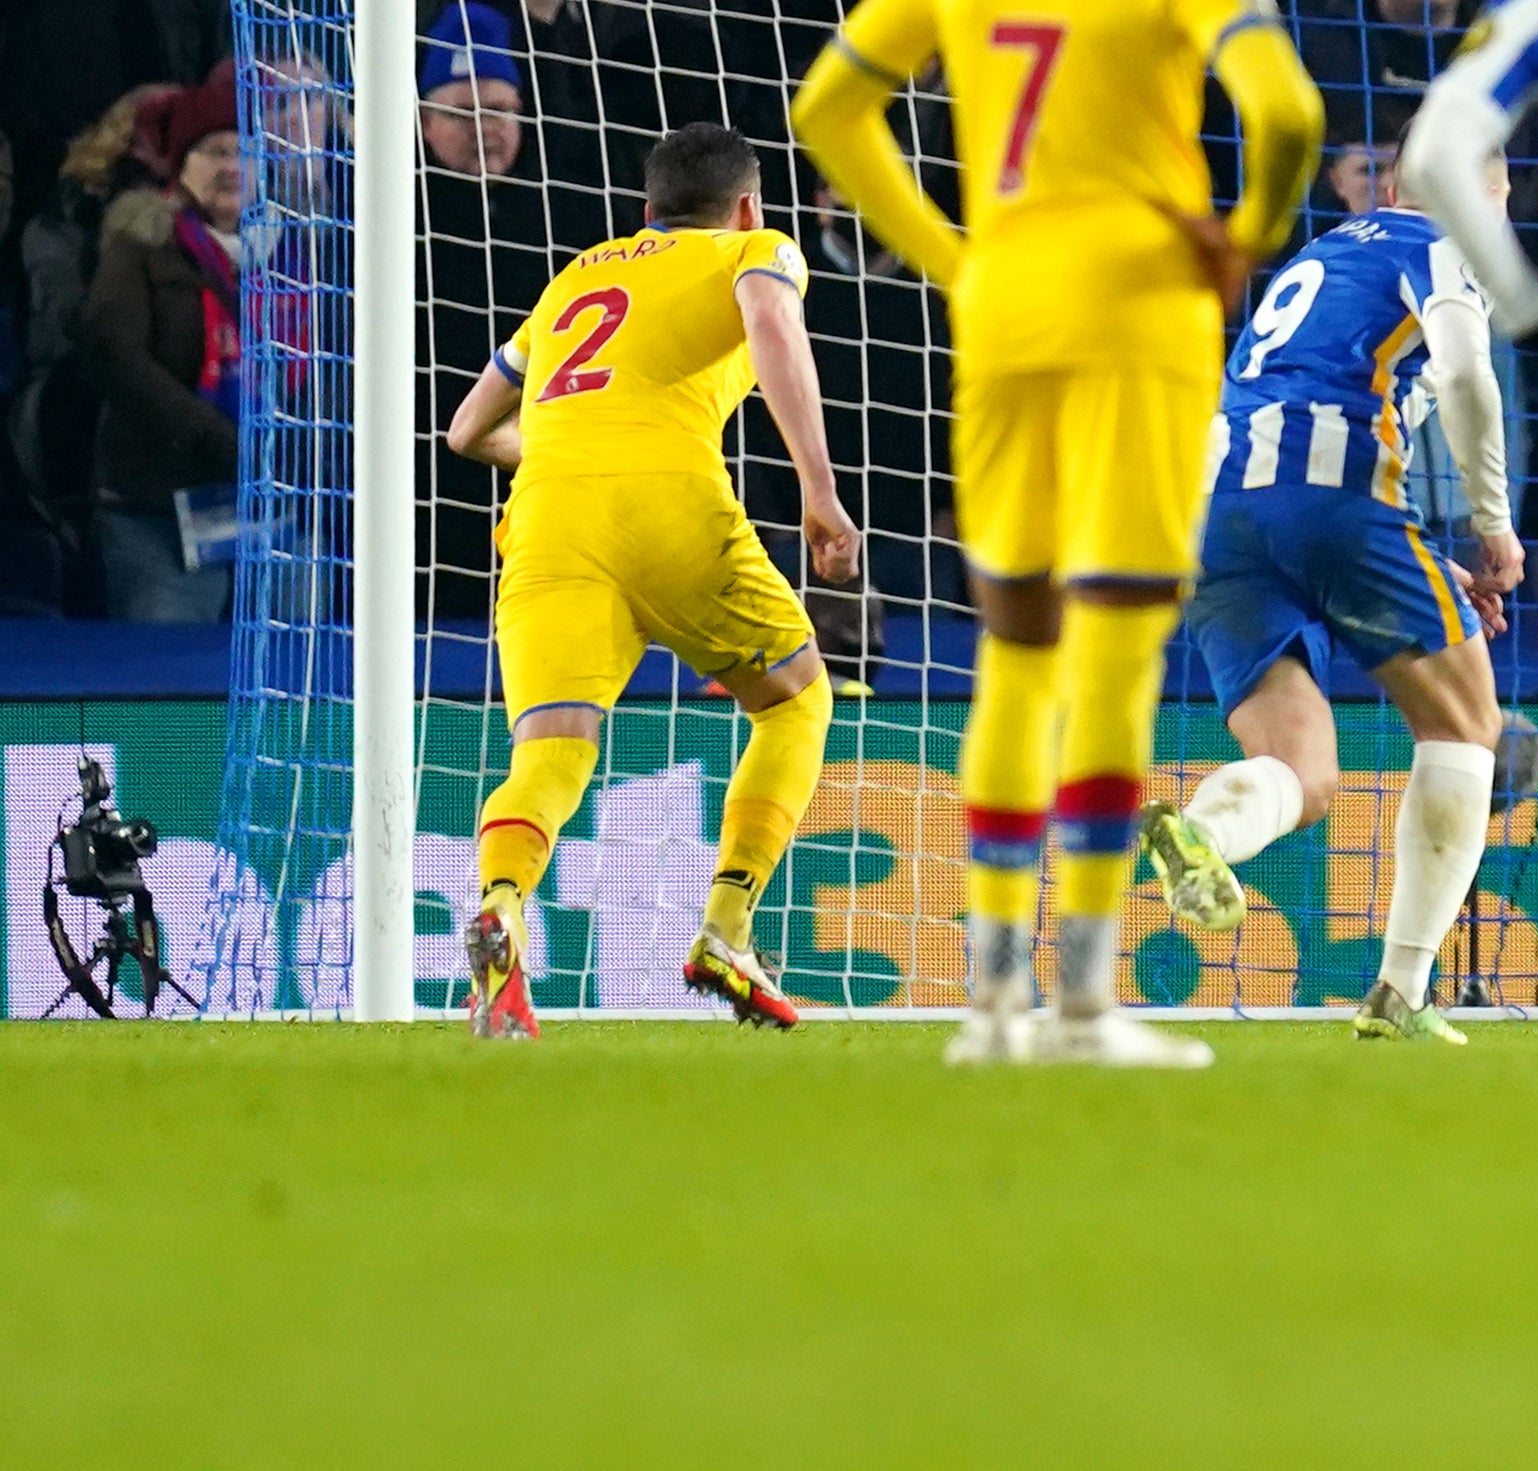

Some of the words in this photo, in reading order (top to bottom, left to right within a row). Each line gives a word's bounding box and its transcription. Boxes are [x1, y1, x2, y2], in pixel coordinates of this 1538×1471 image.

[990, 24, 1068, 196] 7
[534, 286, 632, 404] 2
[1236, 259, 1326, 380] 9
